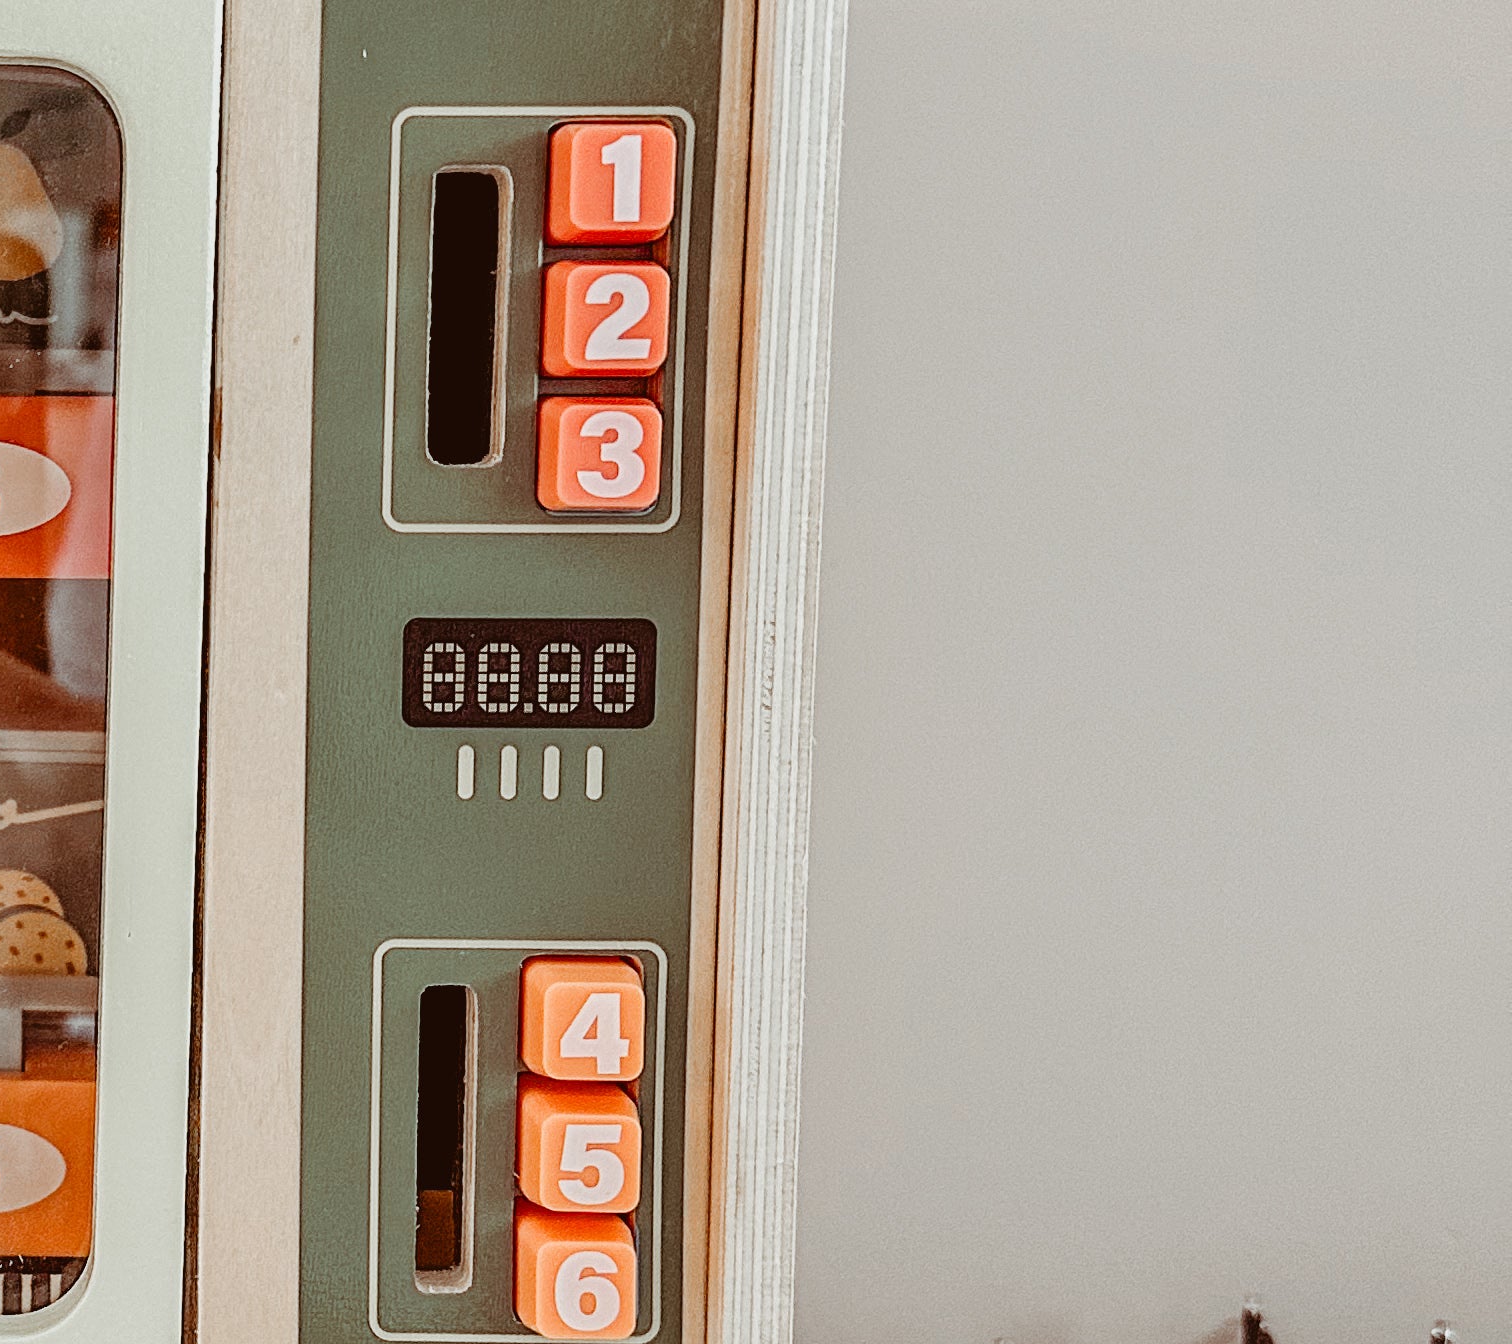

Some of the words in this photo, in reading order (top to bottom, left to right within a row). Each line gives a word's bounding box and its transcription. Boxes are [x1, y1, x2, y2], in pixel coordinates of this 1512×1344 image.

[600, 134, 644, 222] 1
[584, 273, 652, 360] 2
[576, 411, 646, 499] 3
[559, 993, 631, 1075] 4
[557, 1124, 624, 1206] 5
[554, 1250, 620, 1331] 6
